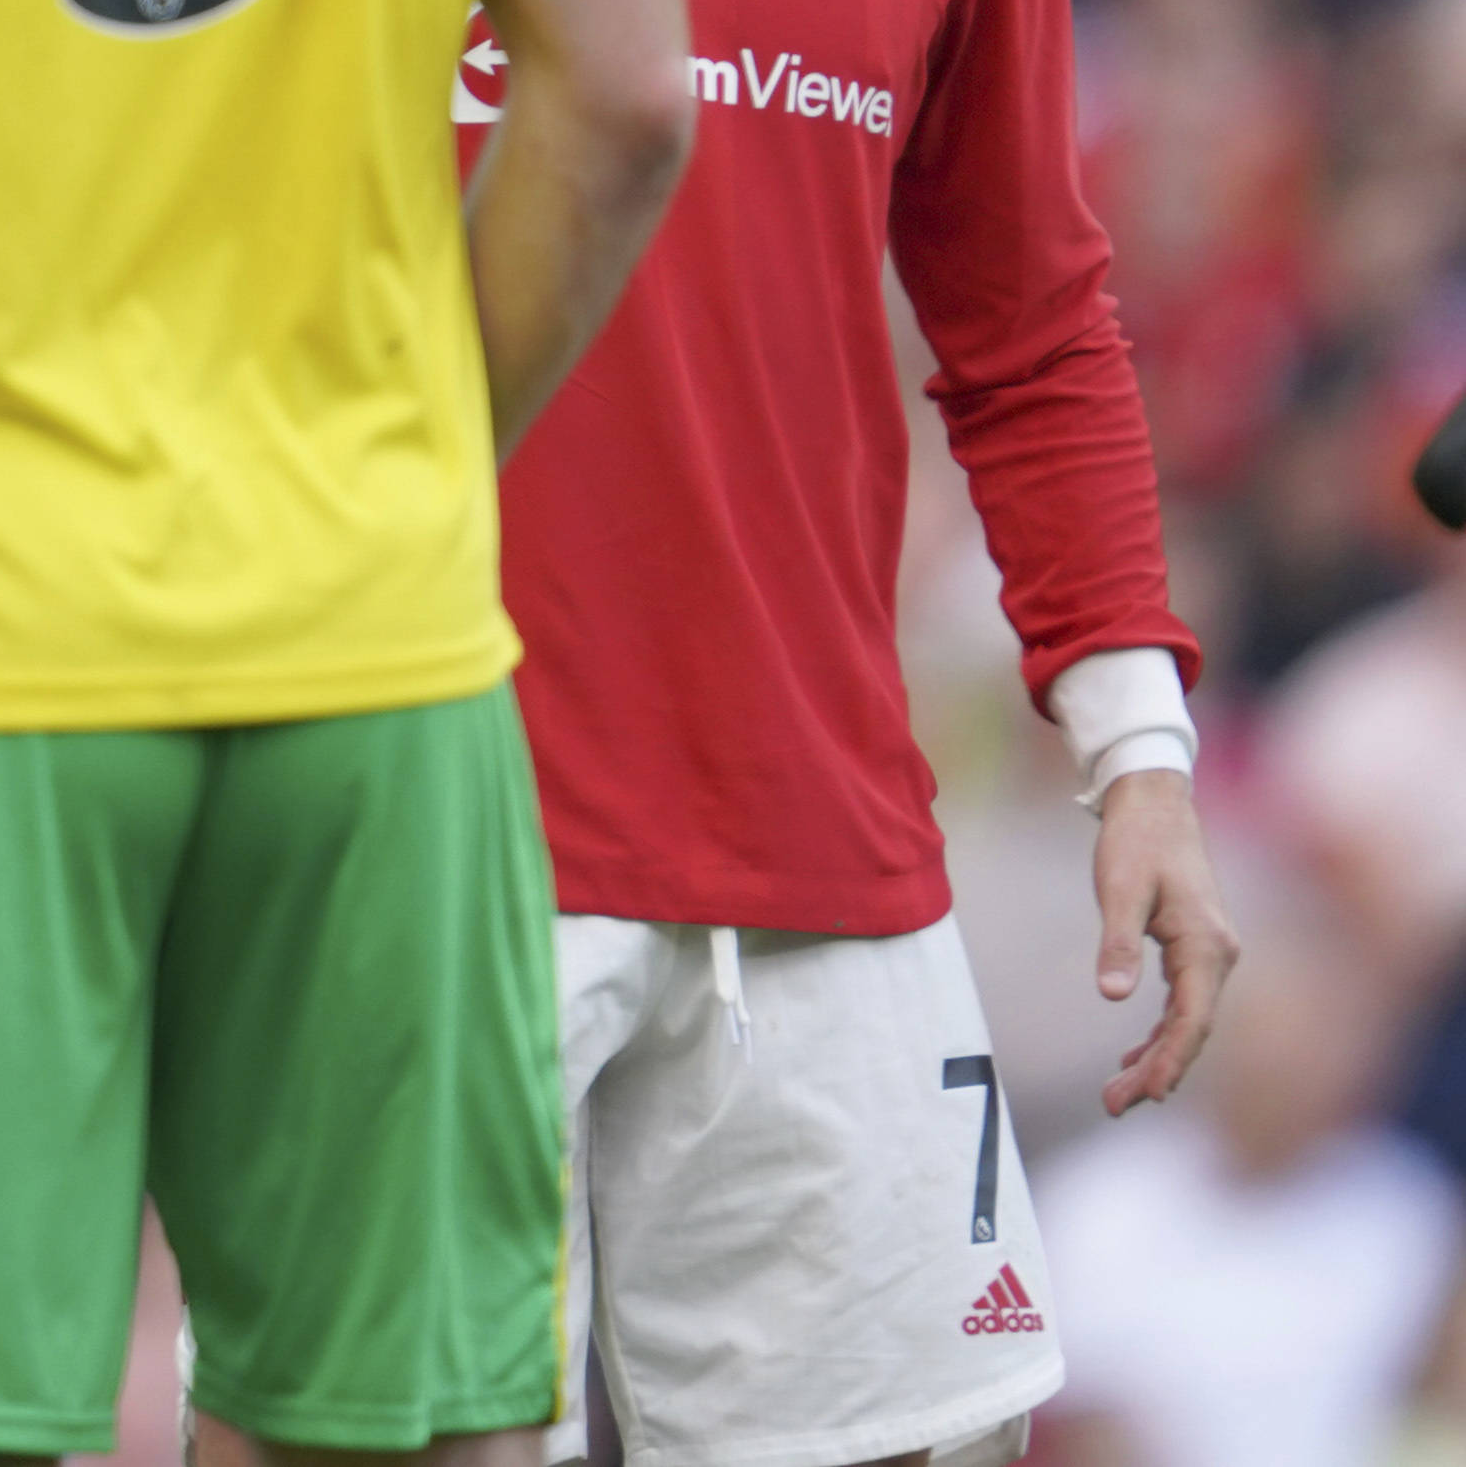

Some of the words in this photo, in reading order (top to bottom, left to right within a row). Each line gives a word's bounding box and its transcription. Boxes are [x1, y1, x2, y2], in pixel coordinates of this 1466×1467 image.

[685, 47, 893, 138] mViewe
[942, 1054, 999, 1244] 7
[962, 1306, 1044, 1336] adidas
